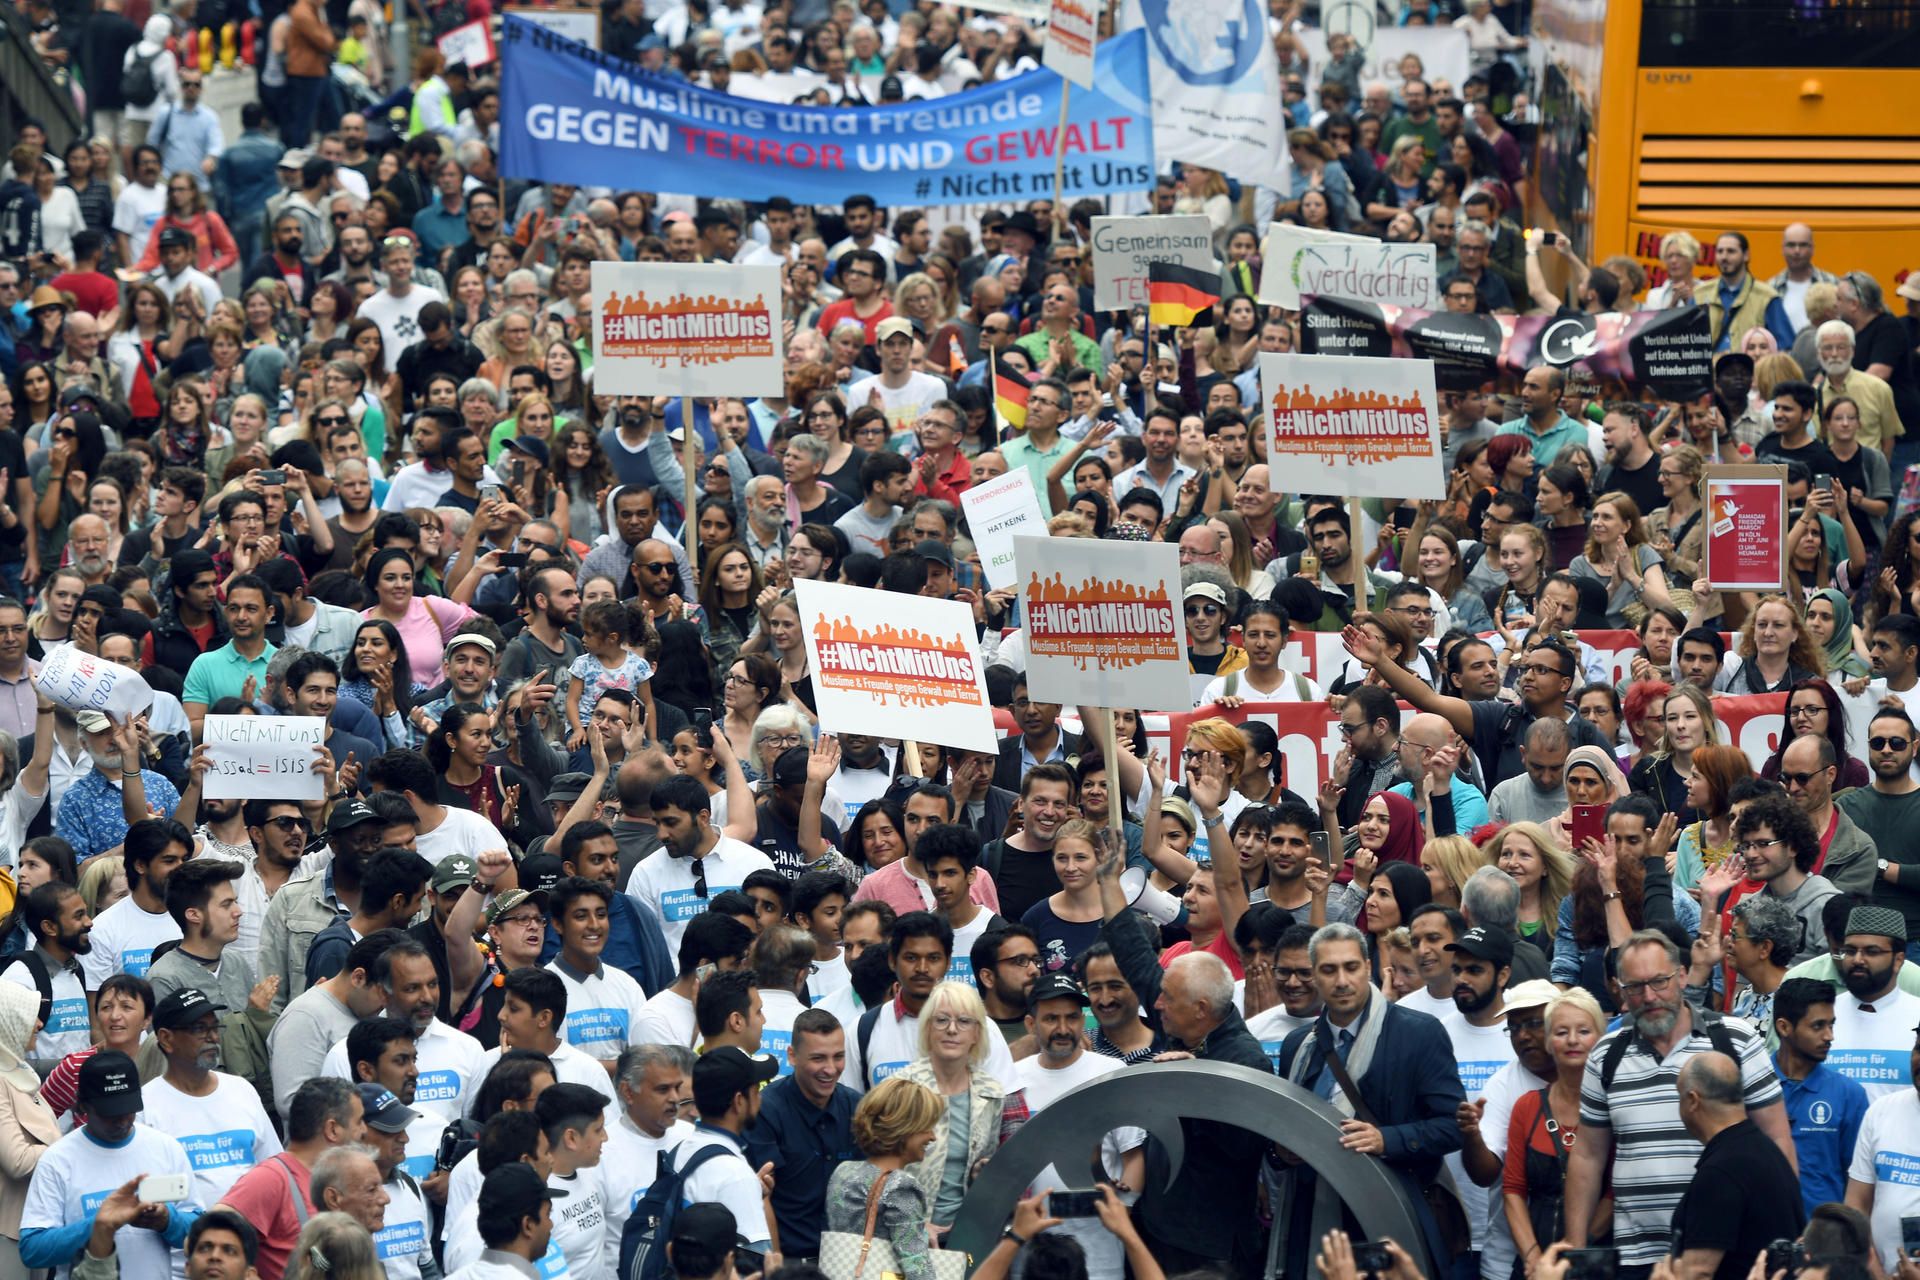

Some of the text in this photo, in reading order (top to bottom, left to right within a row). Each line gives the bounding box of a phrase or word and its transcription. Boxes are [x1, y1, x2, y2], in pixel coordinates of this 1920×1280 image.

[594, 69, 1042, 134] Muslime und Freunde
[525, 104, 669, 152] GEGEN
[678, 126, 845, 170] TERROR
[857, 140, 953, 171] UND
[964, 116, 1132, 165] GEWALT
[915, 163, 1150, 198] # Nicht mit Uns
[1094, 225, 1208, 253] Gemeinsam
[605, 312, 769, 341] #NichtMitUns
[1276, 408, 1428, 436] #NichtMitUns
[971, 479, 1023, 505] TERRORISMUS
[987, 513, 1027, 534] HAT KEINE
[991, 551, 1016, 568] RELI
[1031, 602, 1173, 634] #NichtMitUns
[1031, 639, 1176, 657] Muslime & Freunde gegen Gewalt und Terror
[819, 641, 975, 681] #NichtMitUns
[60, 671, 87, 705] HAT
[822, 674, 979, 702] Muslime & Freunde gegen Gewalt und Terror
[125, 953, 152, 964] Musli
[1823, 1054, 1887, 1065] Muslime für
[431, 1074, 447, 1084] für
[1458, 1064, 1496, 1076] slime
[1838, 1067, 1899, 1079] FRIEDEN
[414, 1086, 456, 1101] IEDEN
[217, 1136, 233, 1148] für
[1875, 1154, 1920, 1171] Muslim
[1890, 1170, 1920, 1184] FRIE
[561, 1197, 593, 1222] MUSLIME
[376, 1229, 409, 1243] uslime
[386, 1239, 423, 1257] FRIEDE
